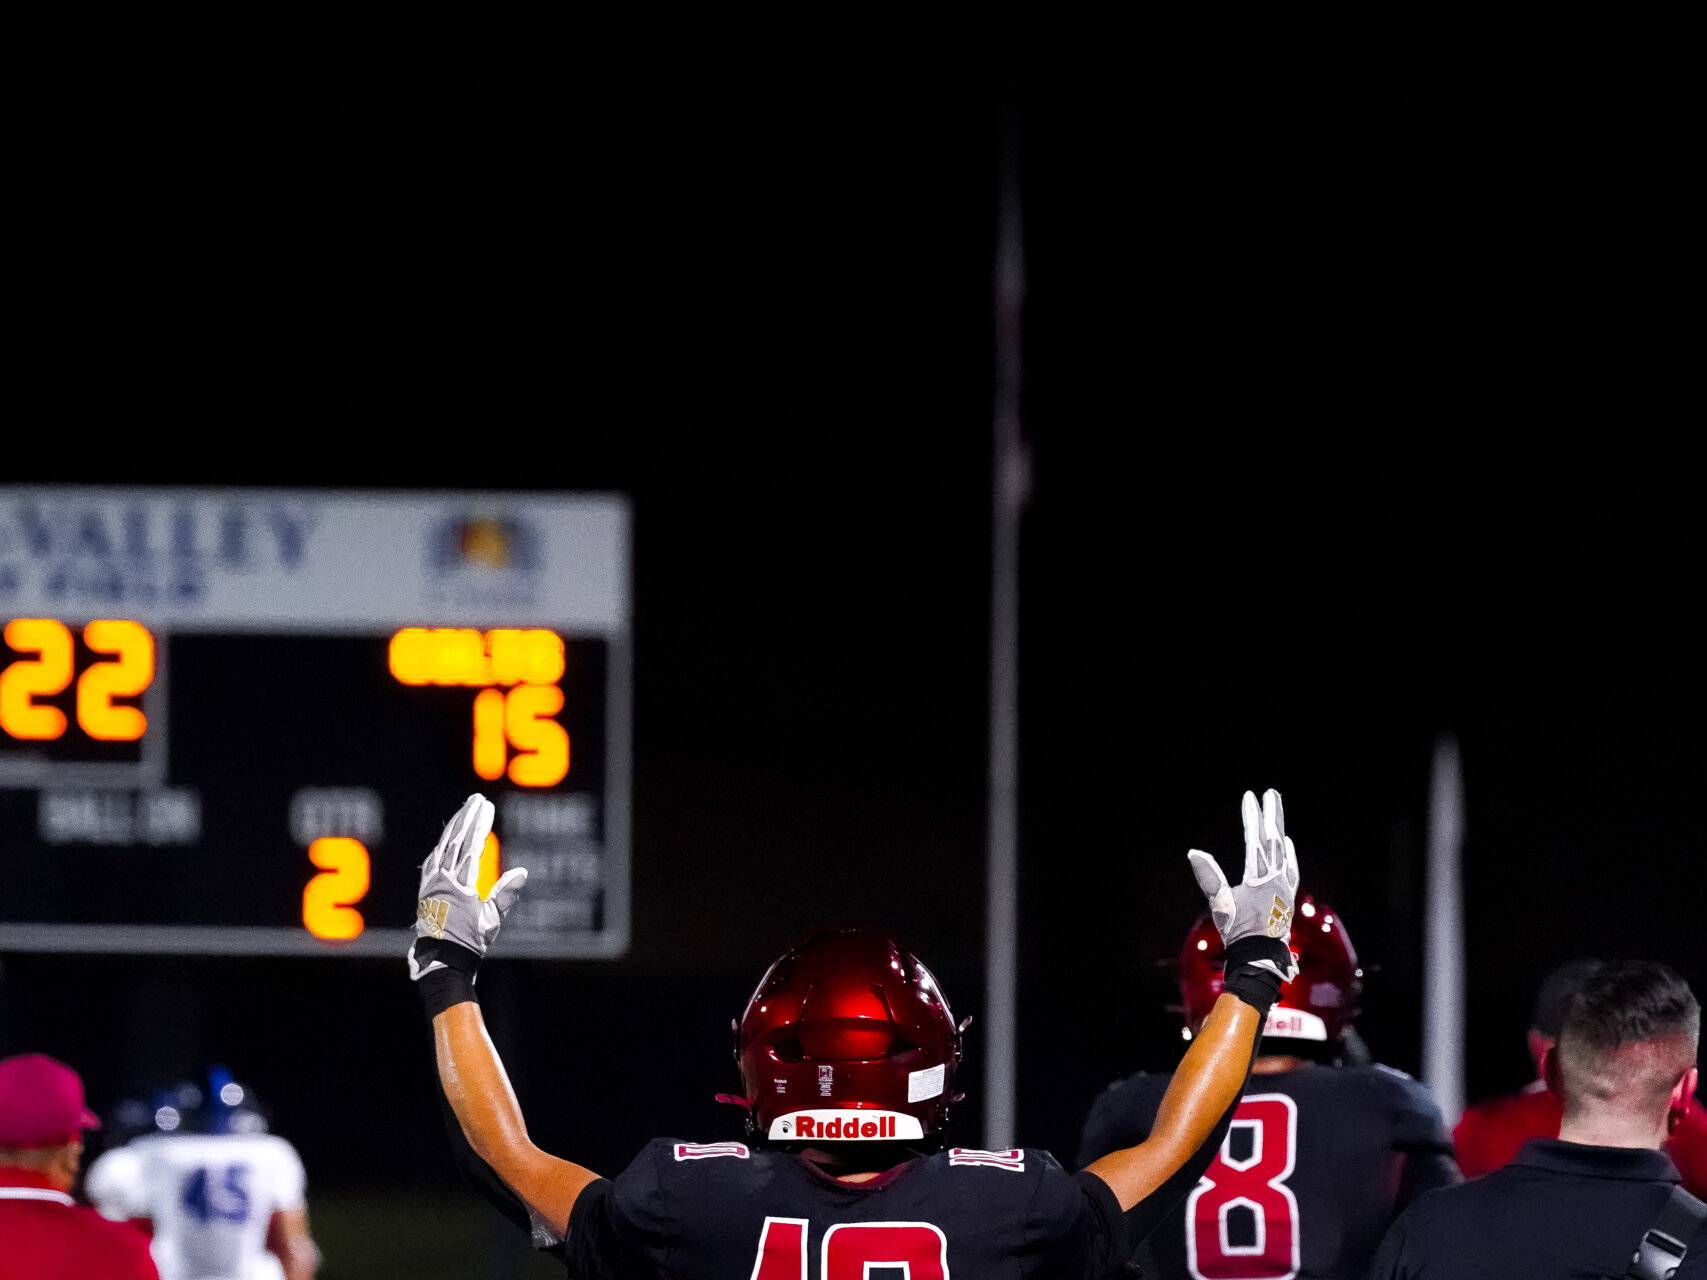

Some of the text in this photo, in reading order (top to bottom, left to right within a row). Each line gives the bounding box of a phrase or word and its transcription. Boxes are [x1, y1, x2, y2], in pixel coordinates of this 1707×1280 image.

[0, 619, 155, 741] 22
[474, 684, 570, 787] 15
[303, 836, 371, 940] 2
[796, 1115, 895, 1139] Riddell
